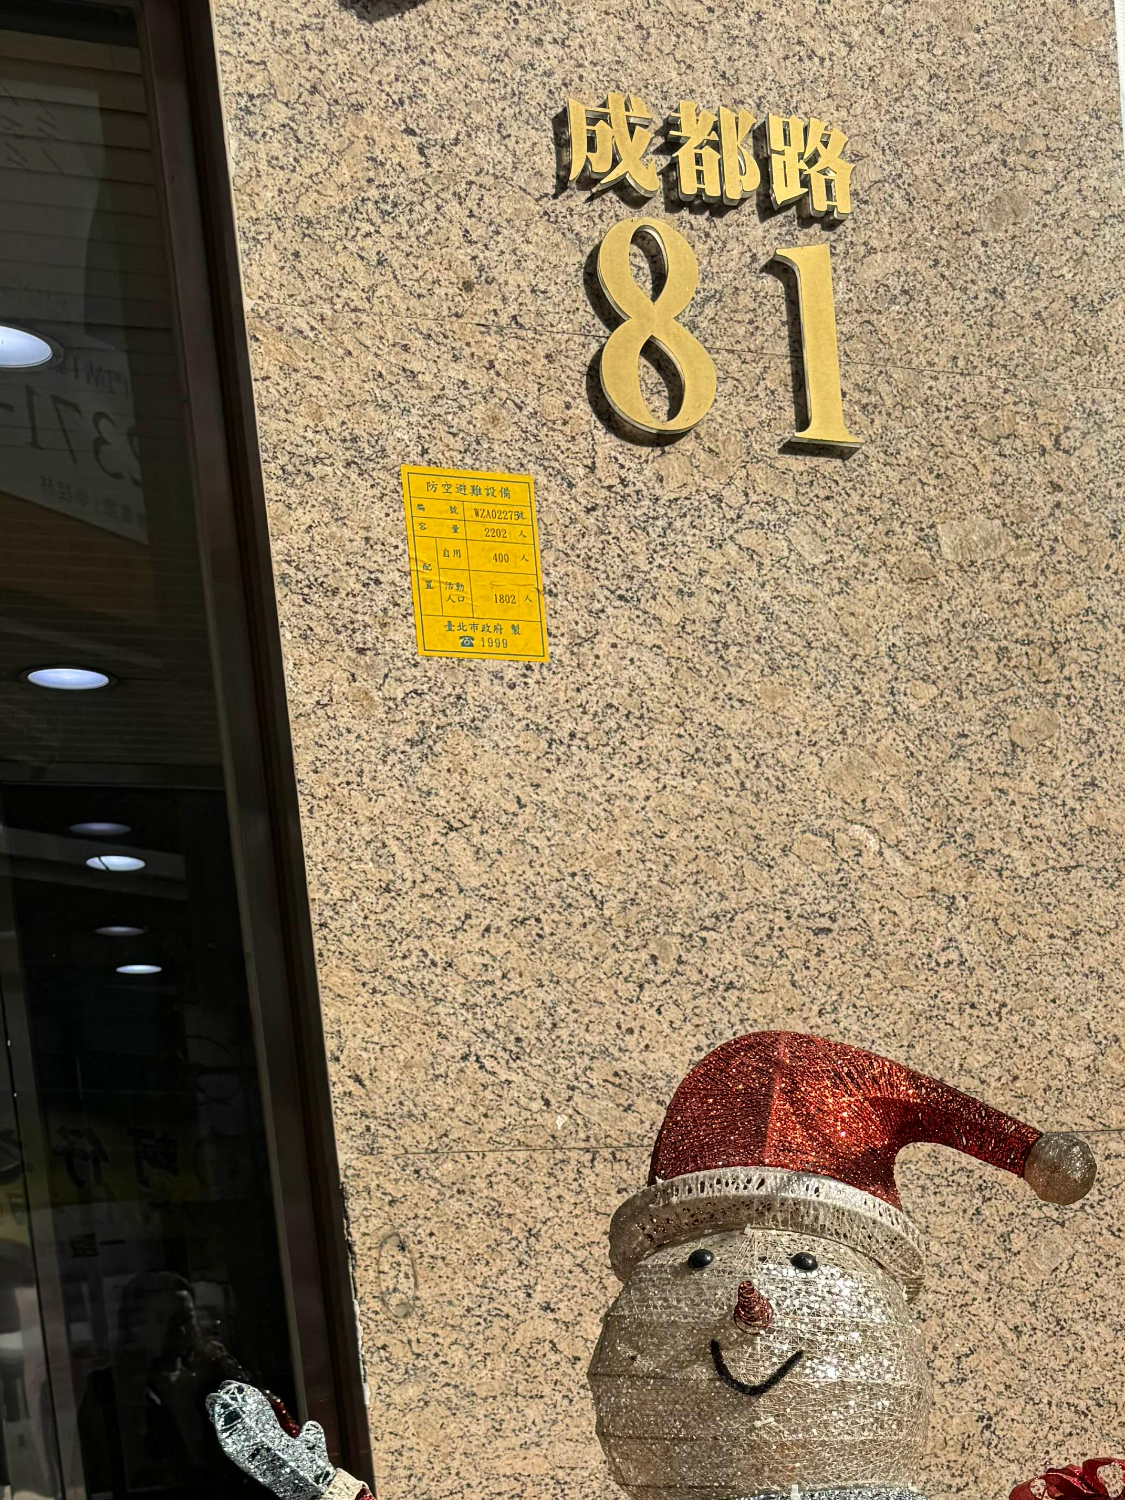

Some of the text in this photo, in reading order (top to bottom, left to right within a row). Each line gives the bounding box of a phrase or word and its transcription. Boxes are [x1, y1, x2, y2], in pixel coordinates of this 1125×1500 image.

[568, 92, 855, 219] 成都路
[597, 216, 864, 449] 81
[426, 481, 511, 499] 防空避難設備
[484, 527, 508, 539] 2202
[442, 548, 462, 559] 自用
[492, 552, 510, 564] 400
[493, 593, 517, 605] 1802
[480, 637, 509, 649] 1999
